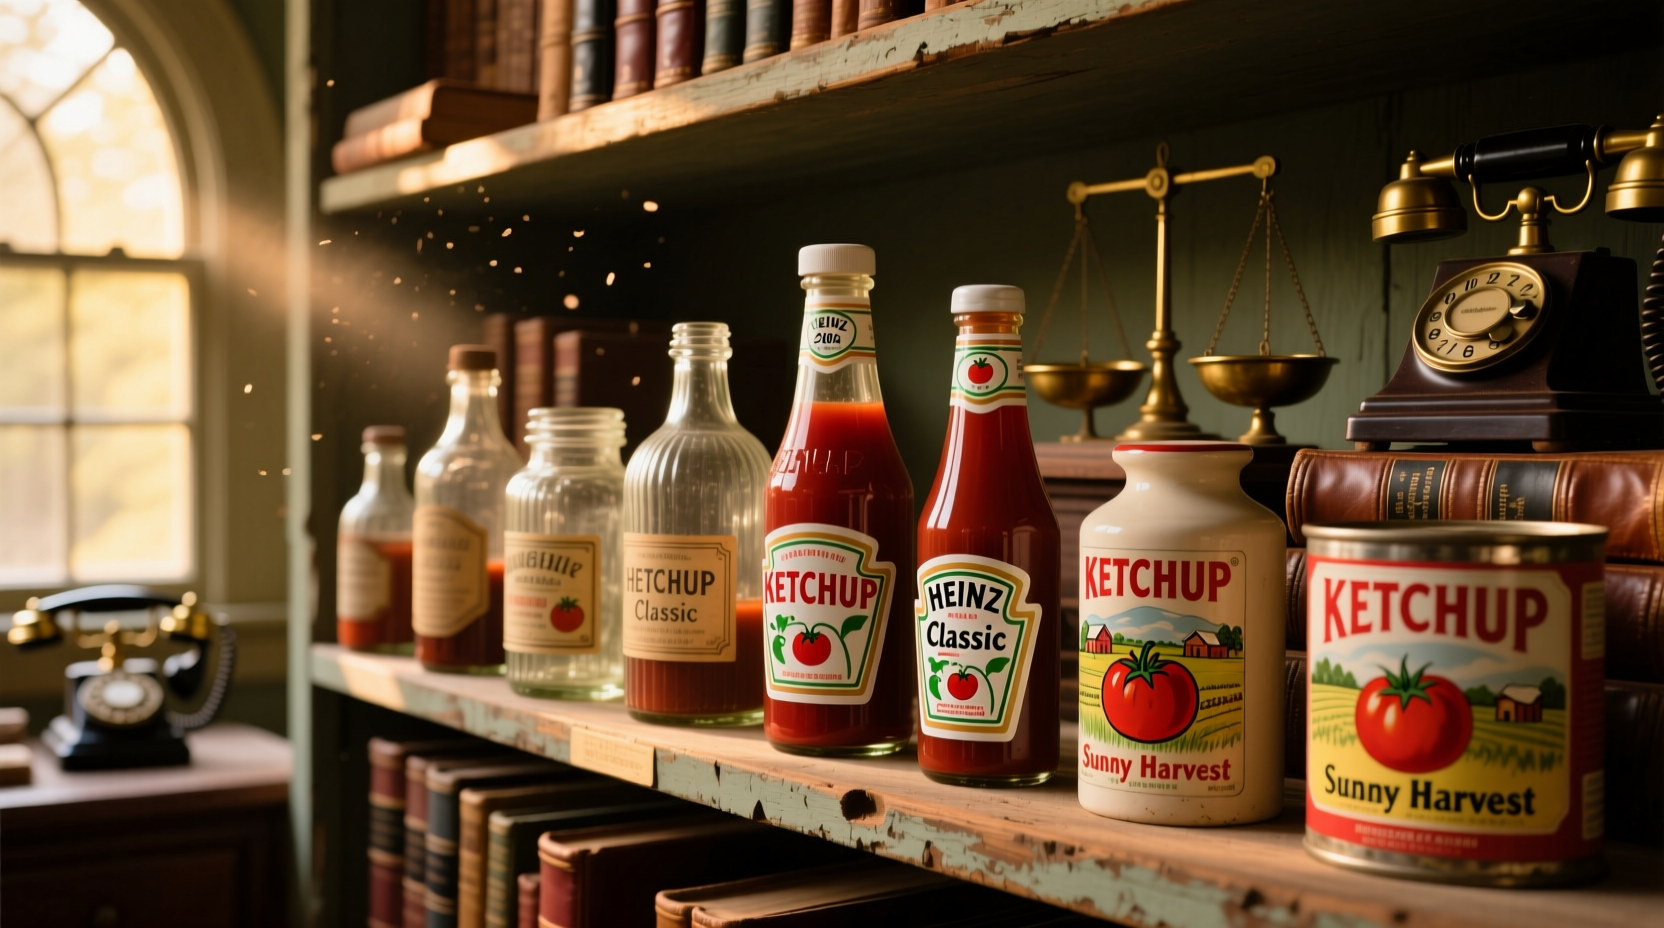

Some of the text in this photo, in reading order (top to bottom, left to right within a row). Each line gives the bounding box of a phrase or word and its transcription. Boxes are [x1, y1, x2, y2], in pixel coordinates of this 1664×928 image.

[626, 567, 715, 596] HETCHUP
[764, 570, 878, 610] KETCHUP
[928, 580, 1004, 614] HEINZ
[1085, 556, 1231, 602] KETCHUP
[635, 599, 698, 623] Classic
[1323, 577, 1549, 654] KETCHUP
[926, 621, 1007, 651] Classic
[1082, 743, 1231, 783] Sunny Harvest
[1324, 764, 1400, 814] Sunny
[1410, 779, 1536, 816] Harvest
